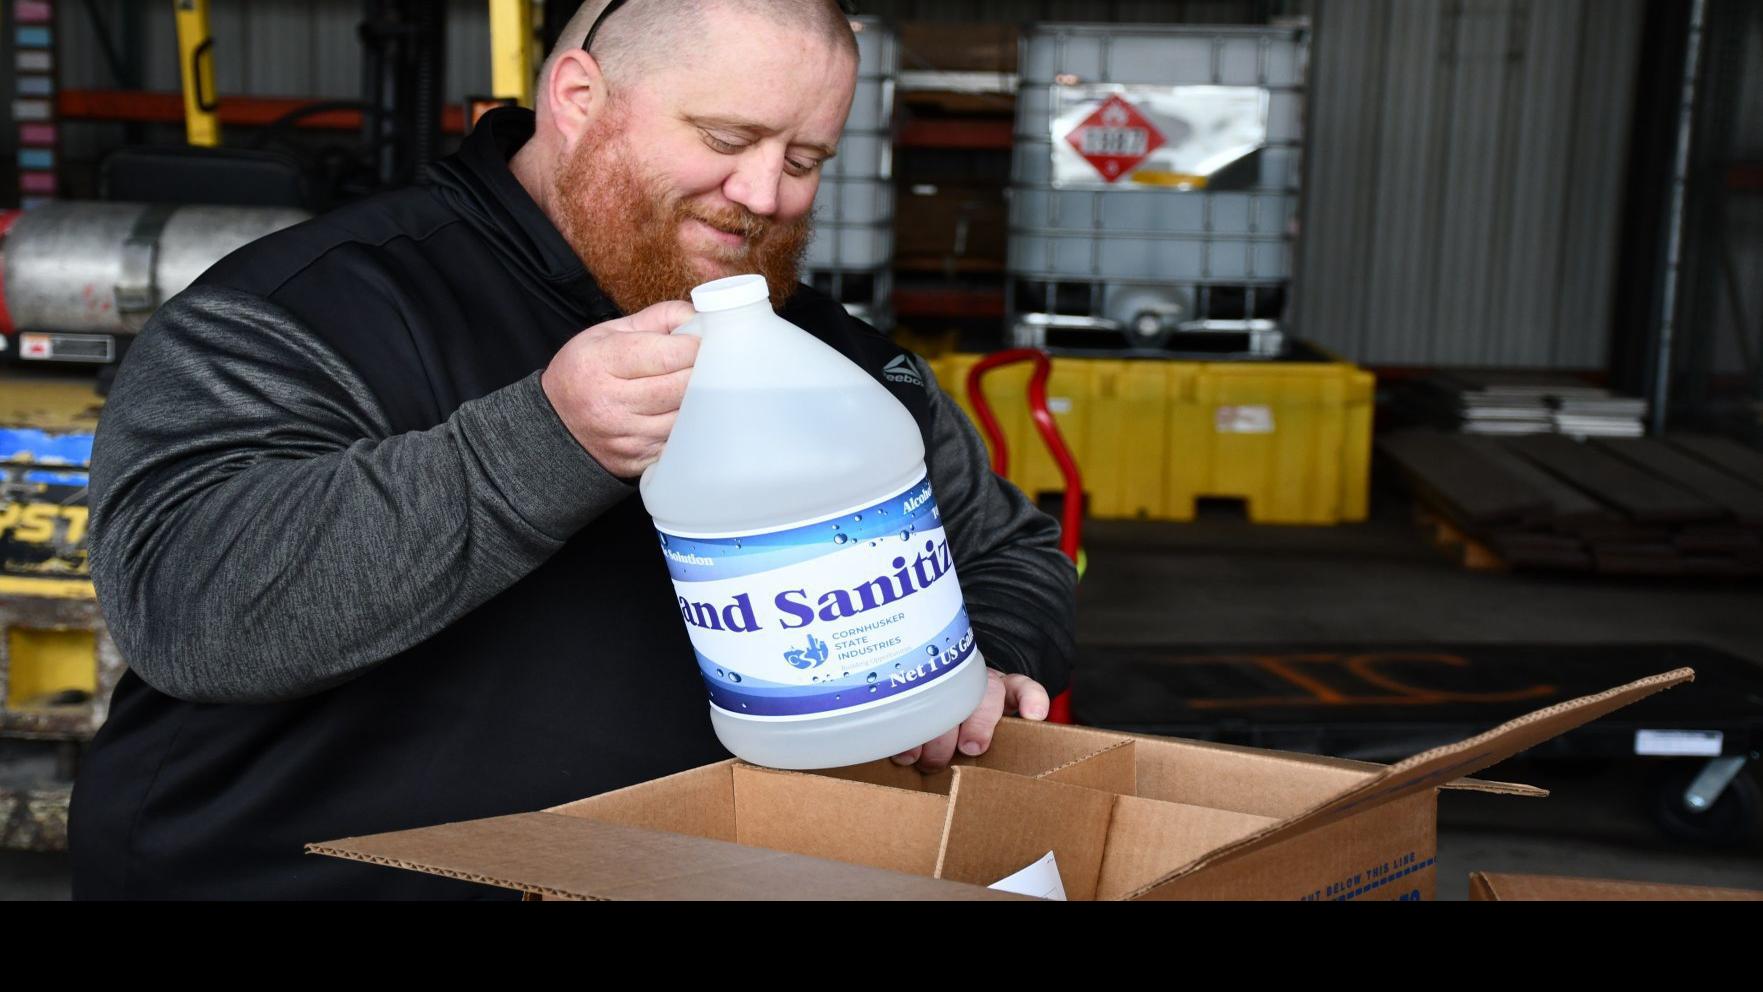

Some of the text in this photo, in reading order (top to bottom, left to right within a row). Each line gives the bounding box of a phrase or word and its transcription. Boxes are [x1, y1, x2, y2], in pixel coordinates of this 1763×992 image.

[679, 538, 953, 633] and Sanitiz
[832, 612, 905, 640] CORNHUSKER
[834, 636, 868, 650] STATE
[838, 636, 903, 661] INDUSTRIES
[889, 664, 926, 688] Net
[941, 644, 959, 665] US
[1326, 875, 1361, 896] BELOW
[1366, 863, 1389, 880] THIS
[1392, 852, 1415, 869] LINE
